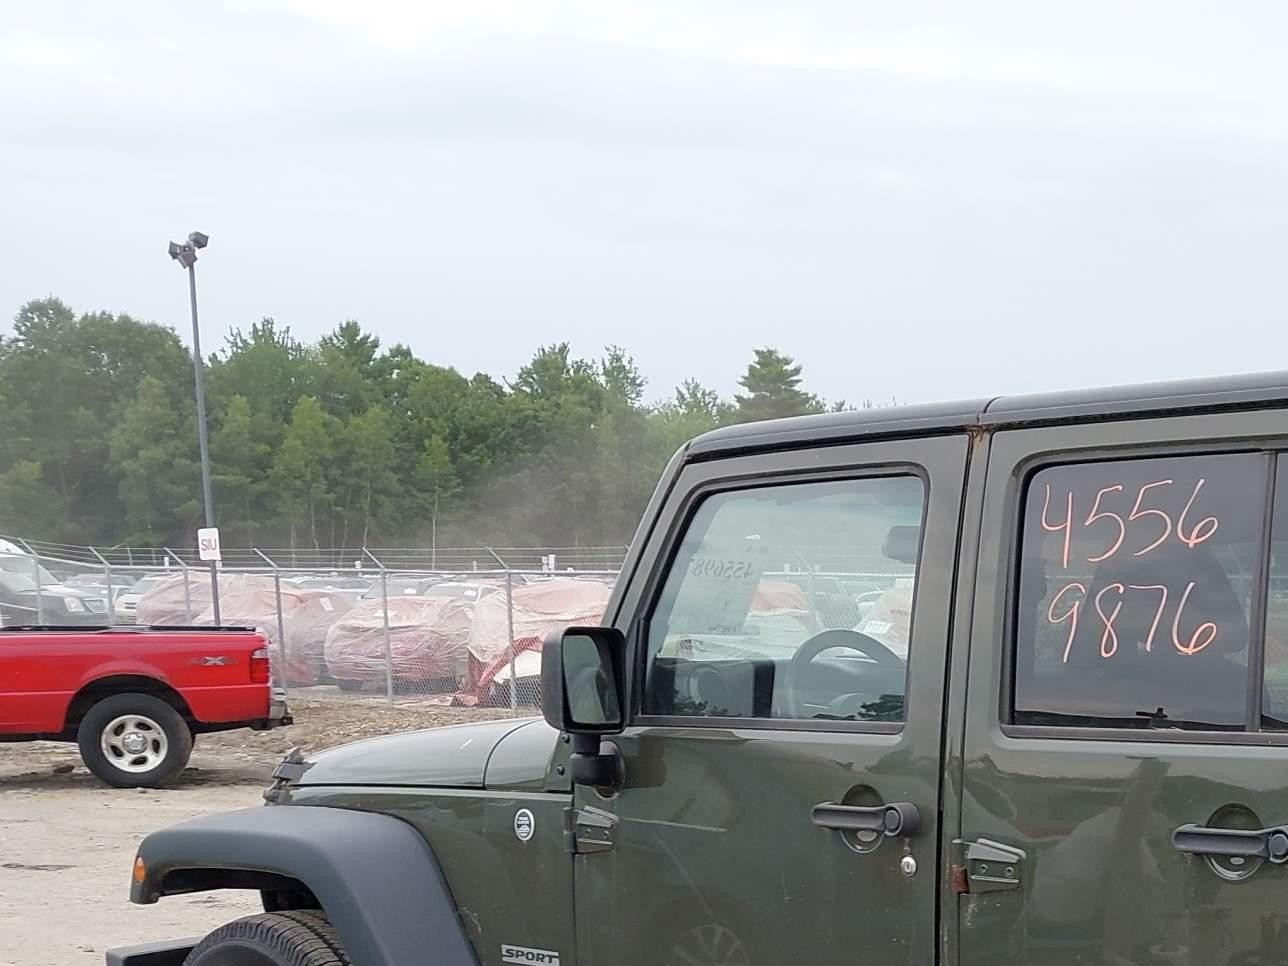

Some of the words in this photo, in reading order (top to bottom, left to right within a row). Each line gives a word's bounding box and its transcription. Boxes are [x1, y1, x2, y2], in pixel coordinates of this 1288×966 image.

[1041, 478, 1219, 569] 4556
[1048, 581, 1218, 664] 9876
[504, 947, 555, 964] SPORT
